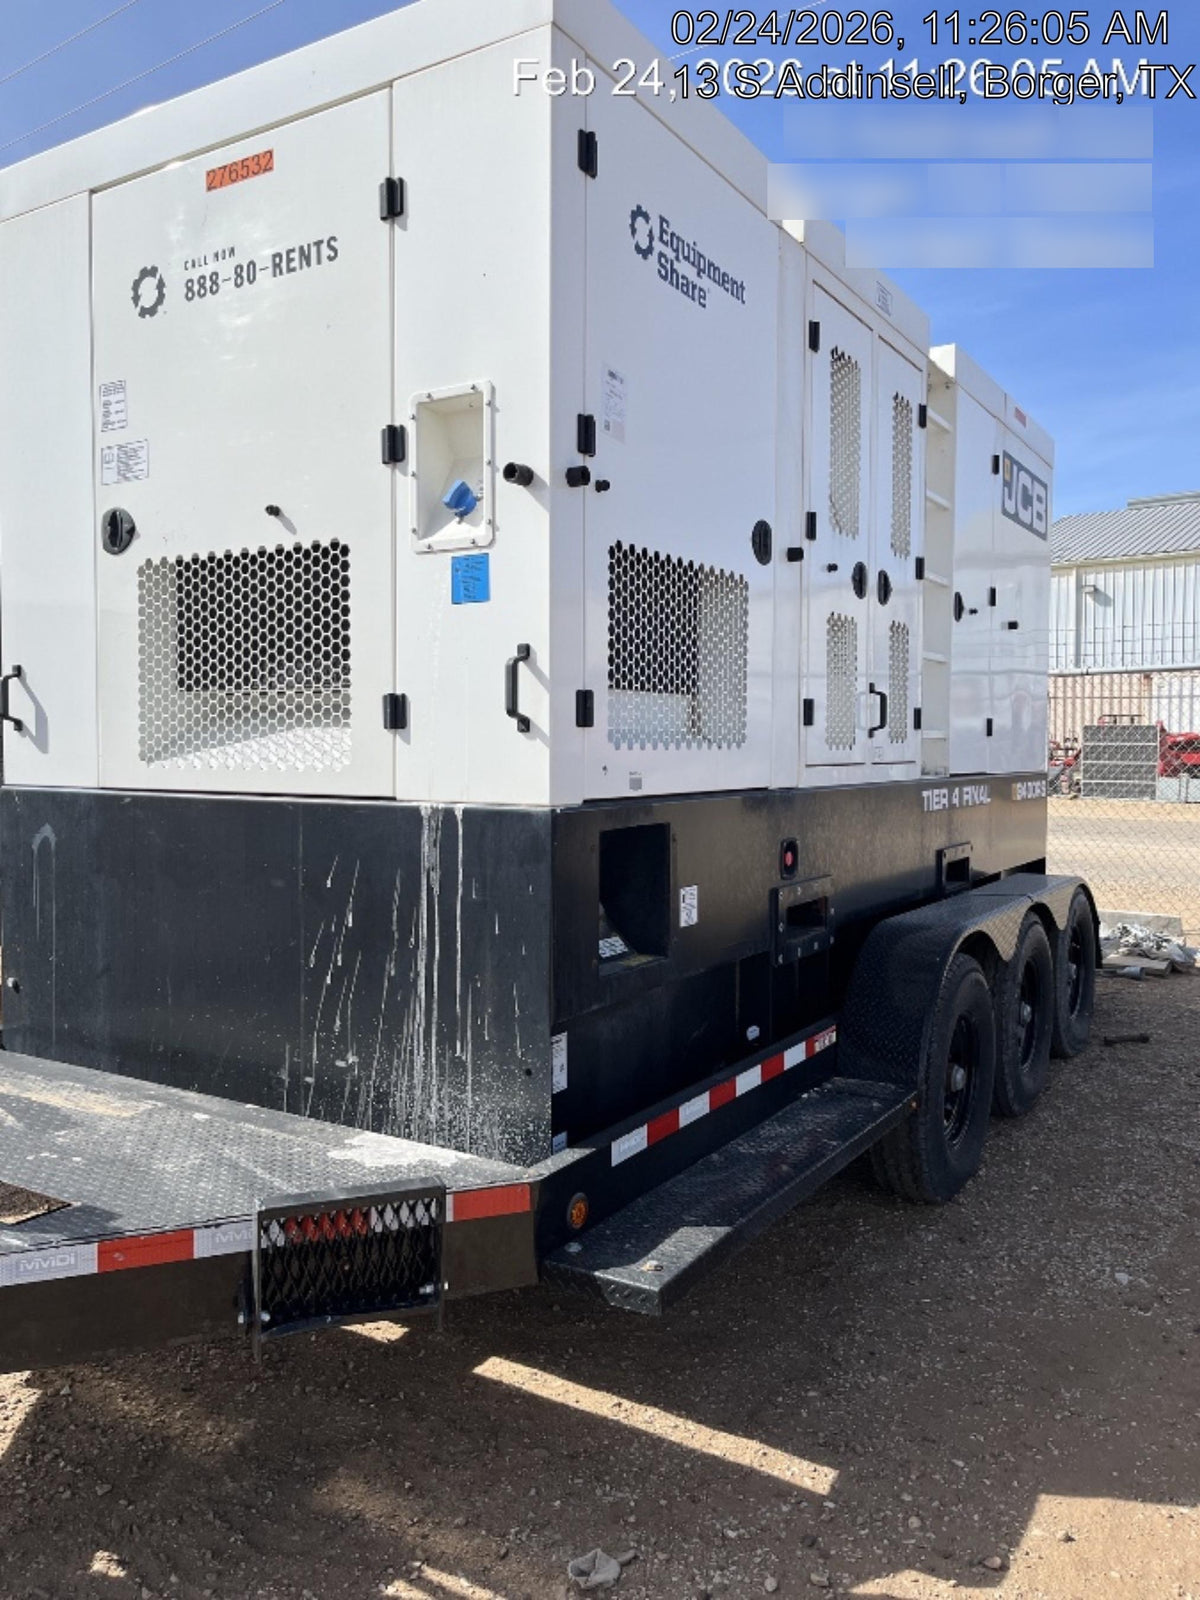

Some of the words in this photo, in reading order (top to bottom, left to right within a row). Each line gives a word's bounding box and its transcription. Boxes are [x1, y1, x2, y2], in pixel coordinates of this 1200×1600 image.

[206, 149, 274, 191] 276532
[184, 255, 208, 271] CALL
[184, 235, 339, 302] 888-80-RENTS
[657, 250, 707, 308] Share
[658, 214, 746, 304] Equipment
[1003, 455, 1047, 537] JCB
[922, 788, 949, 812] TIER
[952, 786, 960, 808] 4
